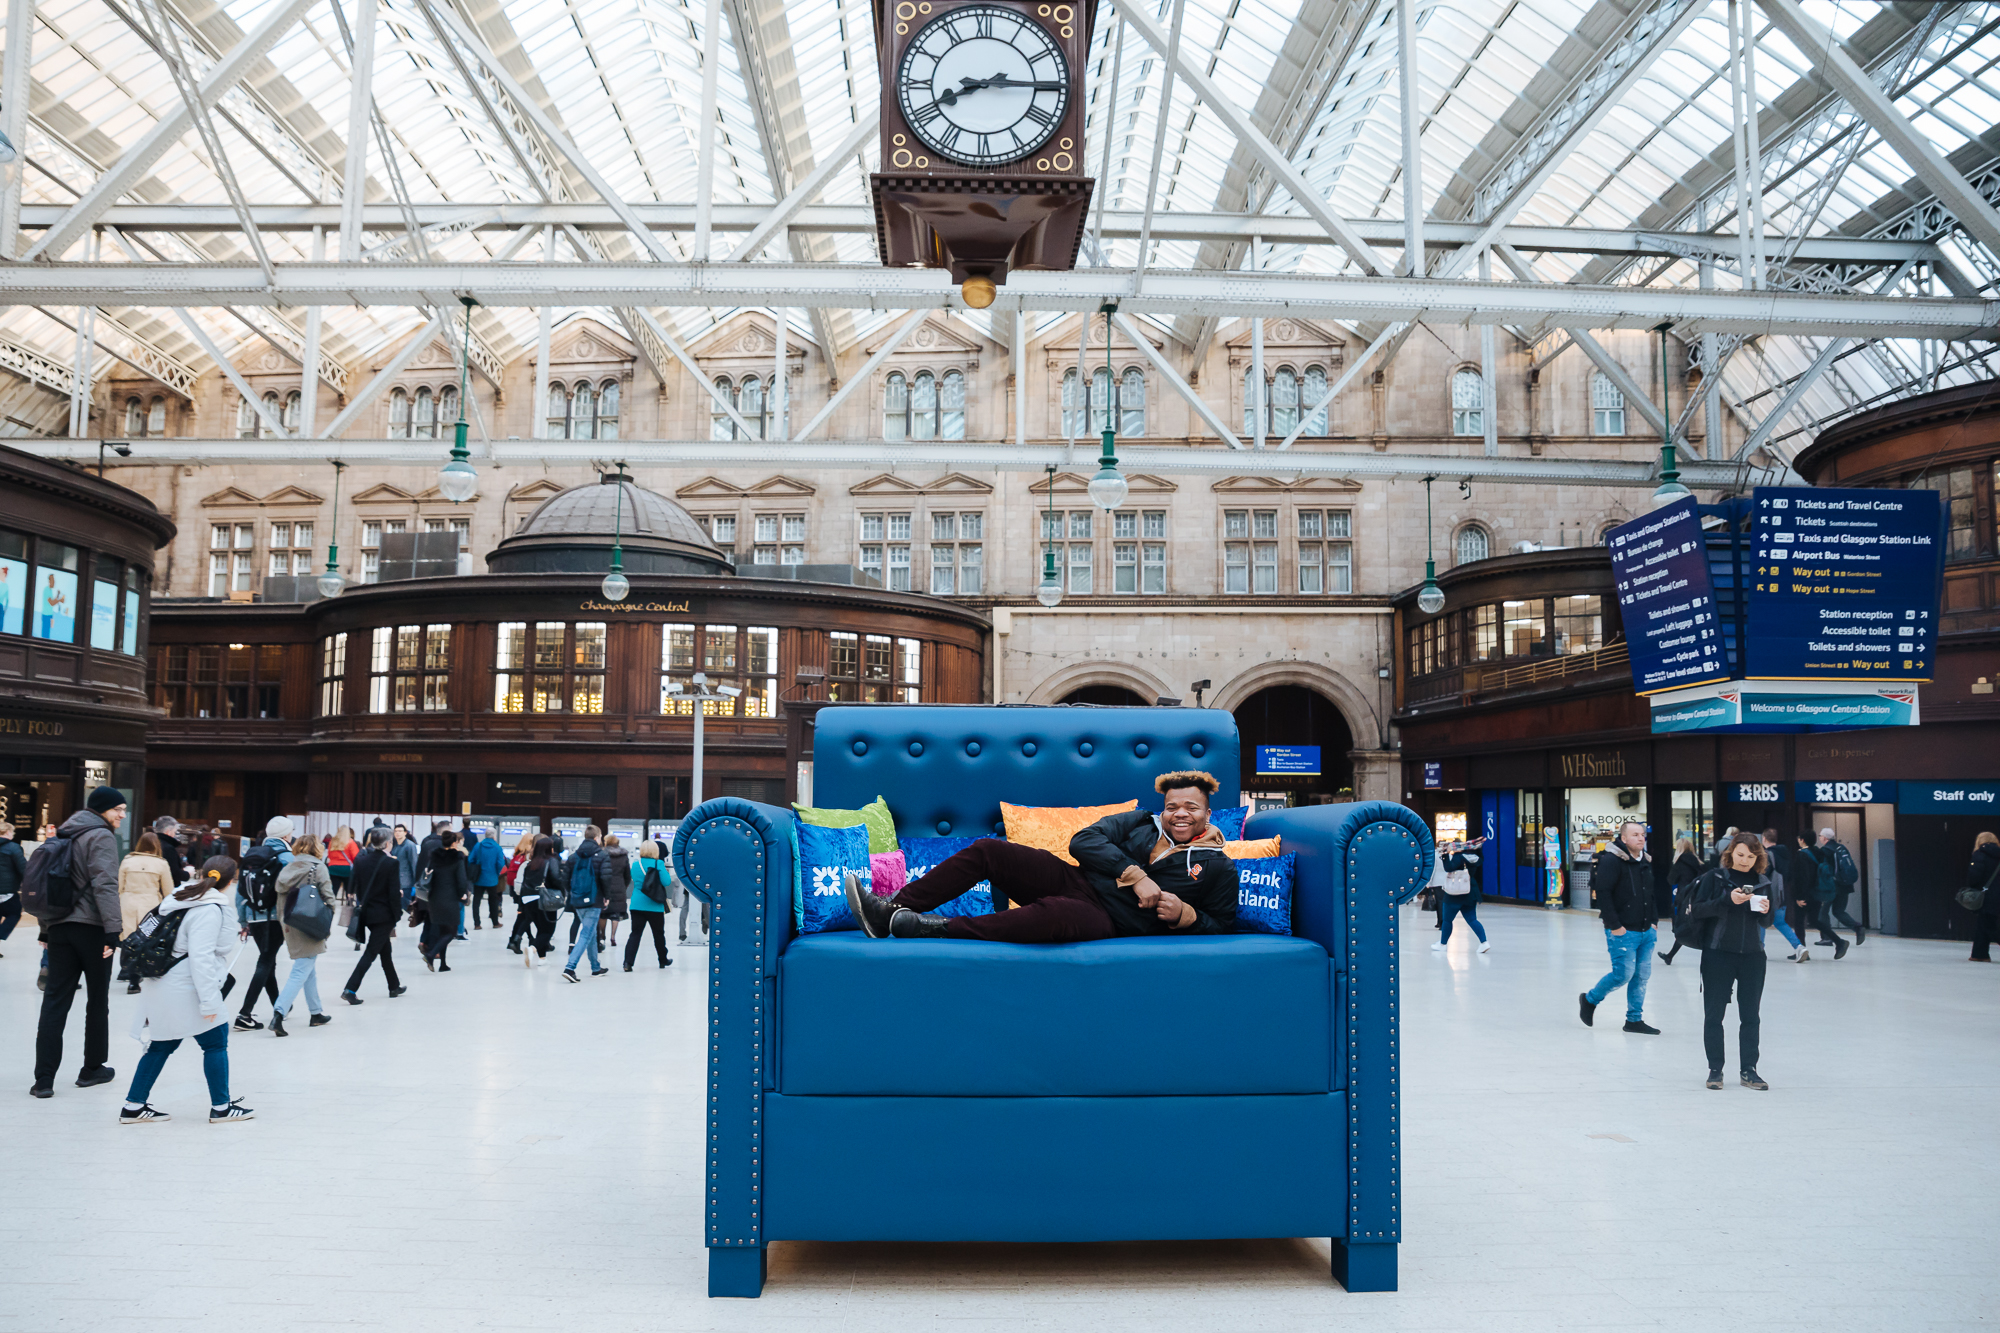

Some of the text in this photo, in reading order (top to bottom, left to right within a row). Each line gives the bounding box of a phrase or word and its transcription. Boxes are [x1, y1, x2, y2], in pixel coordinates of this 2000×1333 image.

[976, 15, 992, 38] XII
[942, 20, 963, 45] XI
[1795, 499, 1903, 511] Tickets and Travel Centre
[1637, 527, 1645, 536] and
[1663, 515, 1680, 527] Station
[1679, 509, 1691, 520] Link
[1795, 516, 1826, 526] Tickets
[1798, 533, 1931, 545] Taxis and Glasgow Station Link
[1792, 550, 1823, 561] Airport
[1825, 551, 1840, 559] Bus
[1793, 567, 1813, 578] Way
[1814, 568, 1830, 577] out
[1633, 576, 1648, 586] Station
[1635, 579, 1688, 600] Tickets and Travel Centre
[1792, 584, 1812, 595] Way
[1814, 585, 1830, 593] out
[580, 600, 690, 612] Champagne Central
[1663, 607, 1671, 616] and
[1671, 603, 1690, 614] showers
[1819, 609, 1893, 620] Station reception
[1665, 622, 1674, 631] Left
[1822, 626, 1891, 635] Accessible toilet
[1808, 642, 1891, 651] Toilets and showers
[1686, 666, 1702, 675] station
[1852, 660, 1872, 670] Way
[1873, 661, 1890, 669] out
[1709, 708, 1725, 716] Station
[1750, 703, 1890, 714] Welcome to Glasgow Central Station
[28, 720, 63, 735] FOOD
[1562, 751, 1626, 778] WHSmith
[1753, 783, 1778, 801] RBS
[1835, 782, 1873, 801] RBS
[1933, 790, 1995, 802] Staff only
[1575, 815, 1593, 823] ING
[1598, 815, 1636, 823] BOOKS
[1240, 870, 1281, 889] Bank
